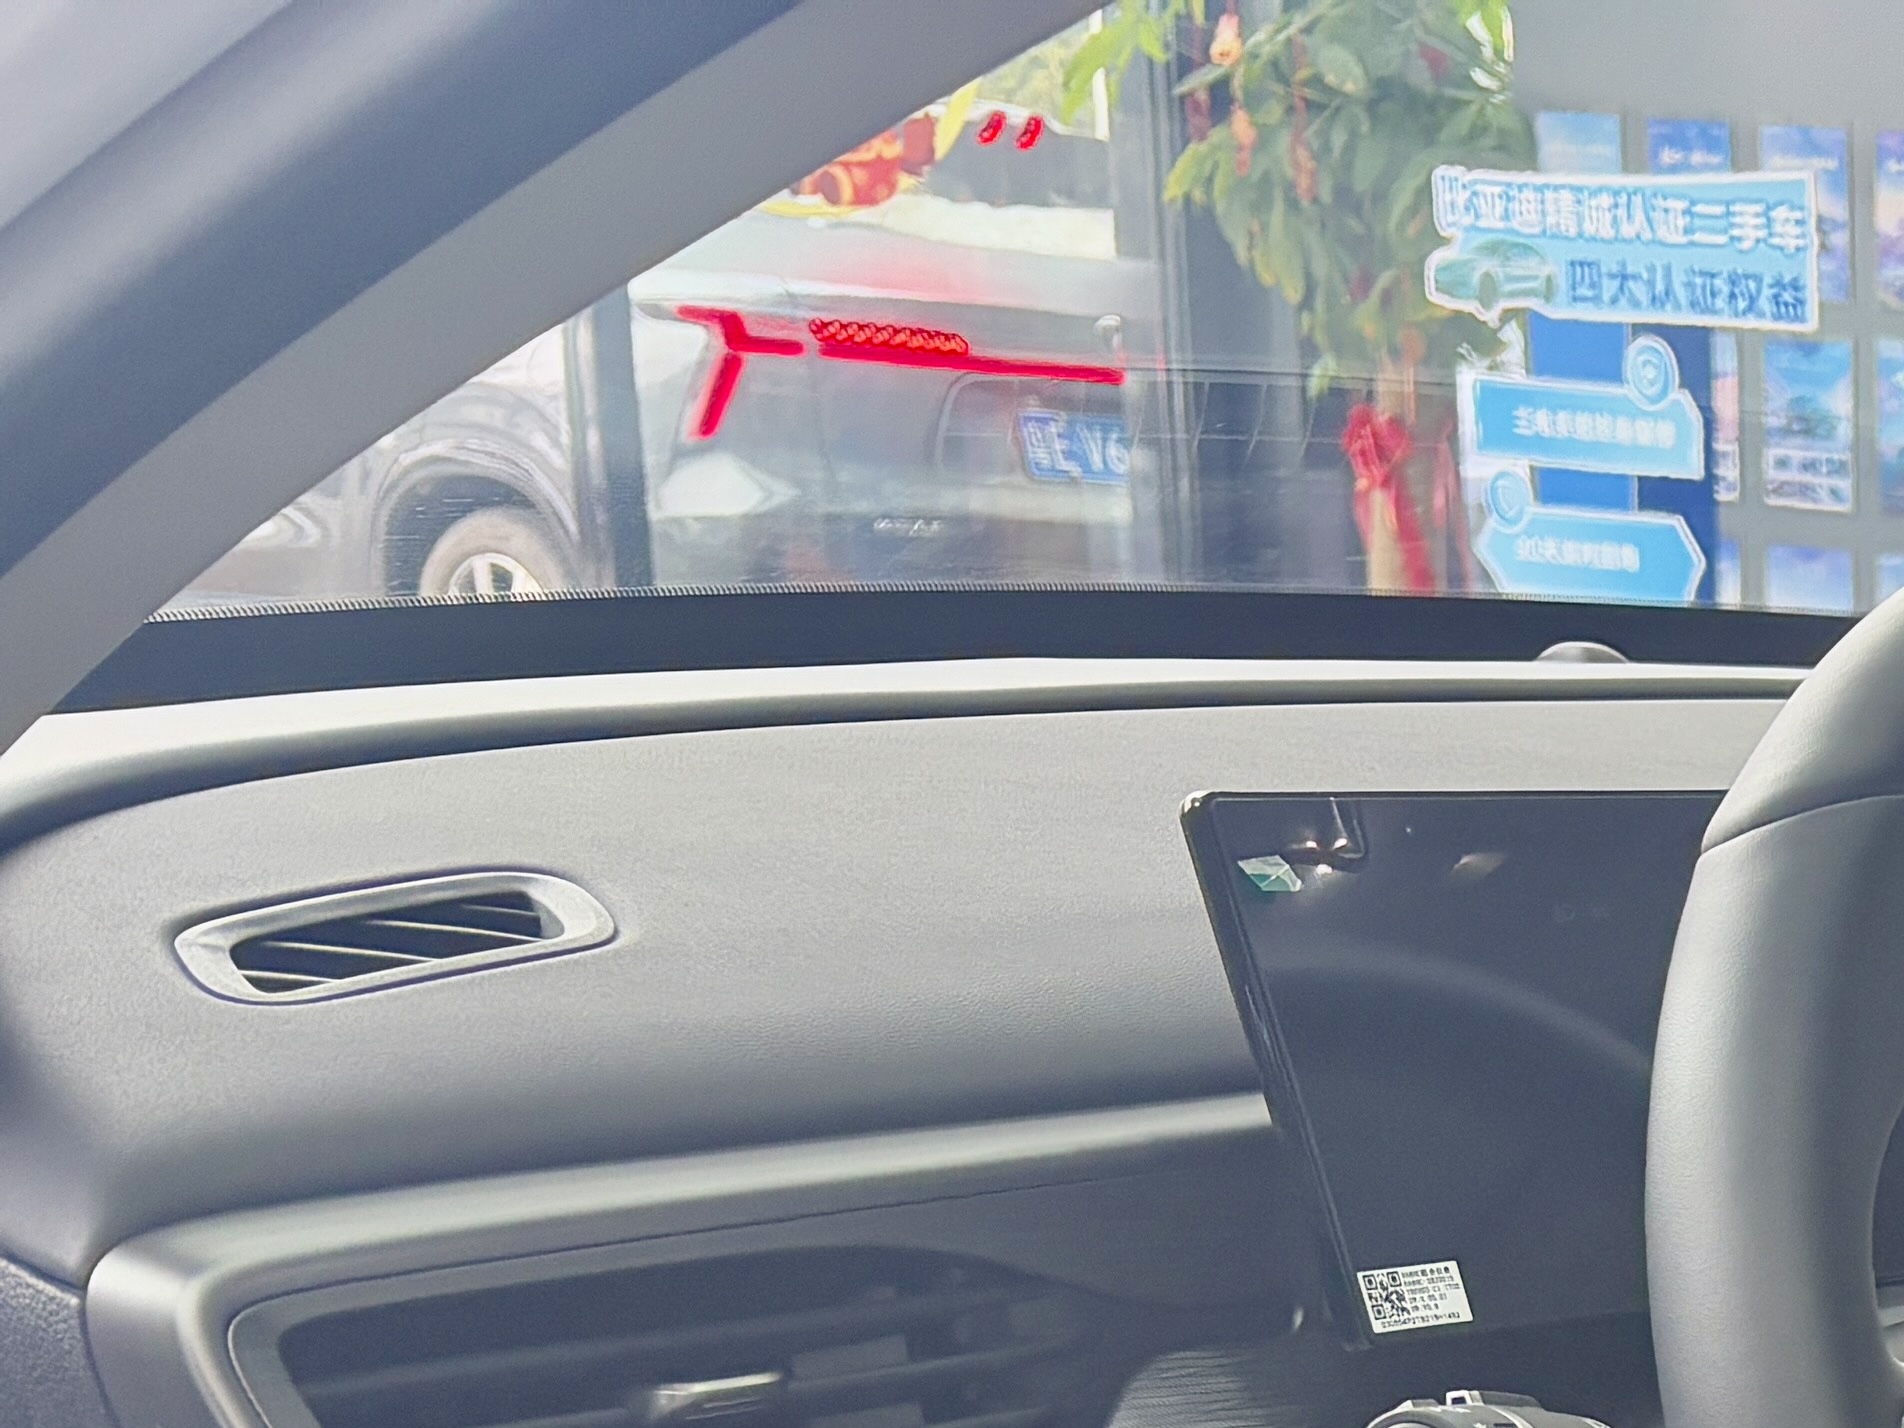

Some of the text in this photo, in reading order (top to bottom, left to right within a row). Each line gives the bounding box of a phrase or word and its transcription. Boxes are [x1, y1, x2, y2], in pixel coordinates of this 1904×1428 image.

[1440, 174, 1805, 252] 比亚迪精诚认证二手车
[1569, 259, 1806, 322] 四大认证权益
